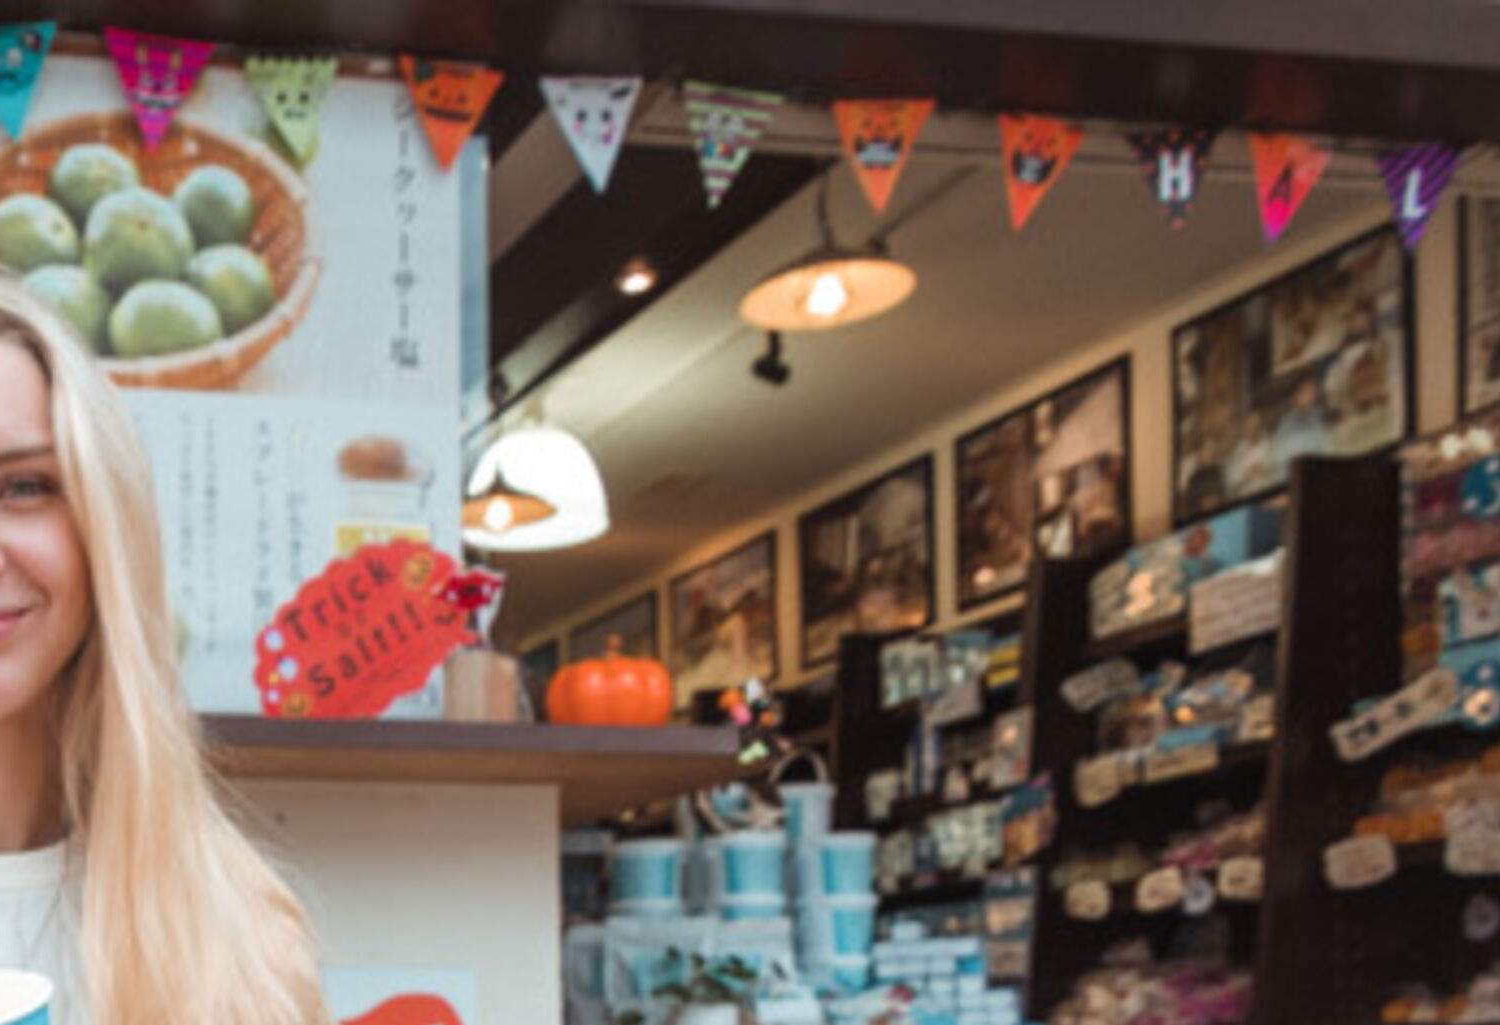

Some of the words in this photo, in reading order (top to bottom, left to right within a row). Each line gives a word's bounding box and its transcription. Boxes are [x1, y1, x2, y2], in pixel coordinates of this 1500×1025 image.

[1157, 148, 1193, 202] H
[1270, 160, 1293, 204] A
[1402, 169, 1428, 220] L
[283, 558, 394, 642] Trick
